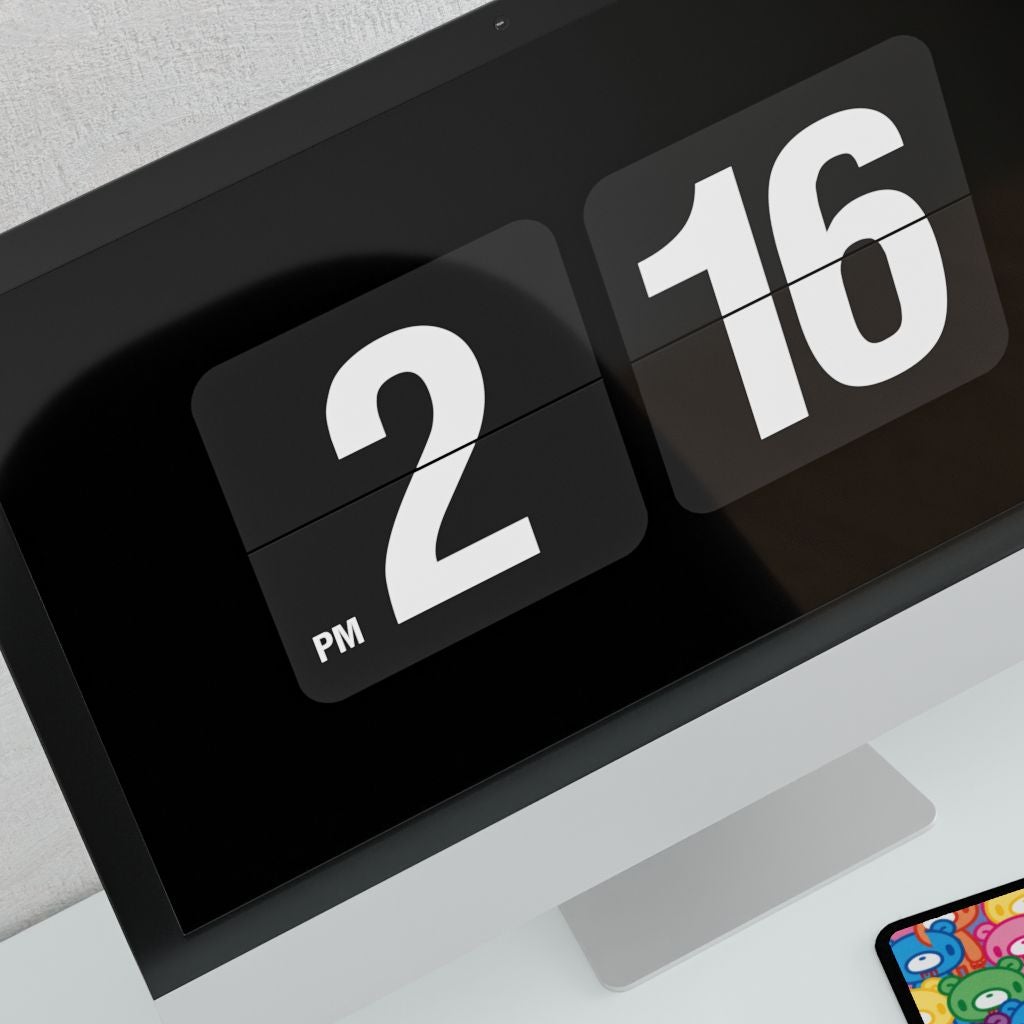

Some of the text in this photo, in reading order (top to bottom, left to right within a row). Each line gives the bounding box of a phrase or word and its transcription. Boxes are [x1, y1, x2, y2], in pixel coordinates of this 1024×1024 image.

[326, 108, 947, 624] 2 16
[312, 617, 364, 663] PM
